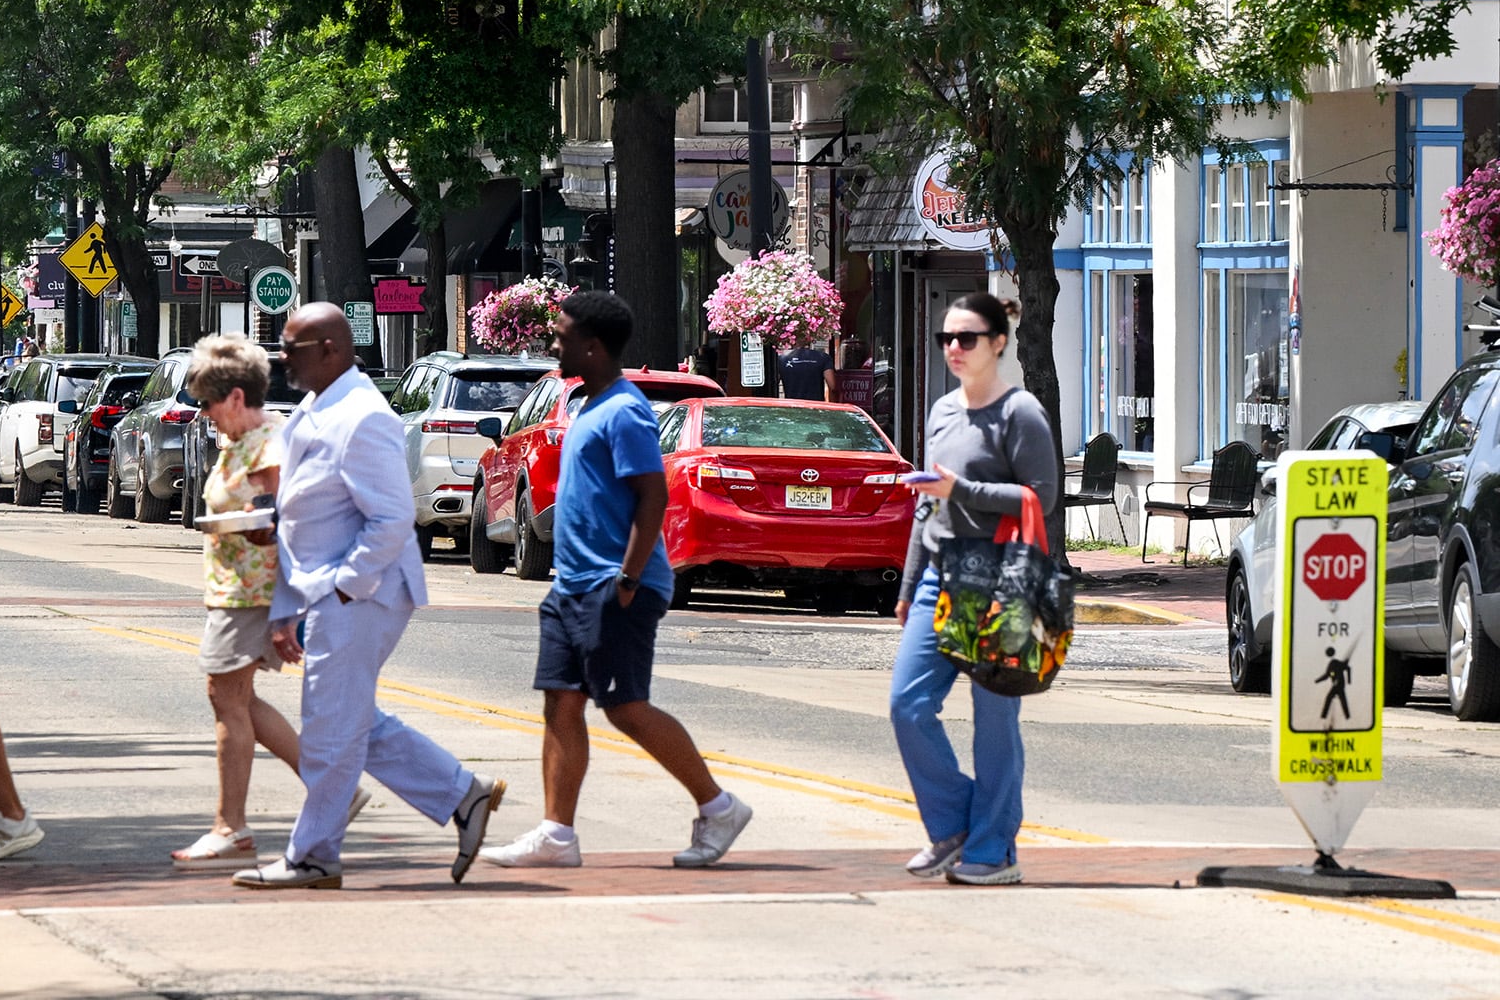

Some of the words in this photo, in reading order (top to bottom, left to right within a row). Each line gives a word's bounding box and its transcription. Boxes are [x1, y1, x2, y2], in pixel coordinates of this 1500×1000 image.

[716, 191, 780, 214] cany
[152, 256, 166, 265] AY
[199, 260, 216, 270] ONE
[266, 276, 283, 286] PAY
[258, 287, 291, 297] STATION
[347, 305, 354, 317] 3
[742, 334, 748, 350] 3
[842, 380, 869, 391] COTTON
[844, 391, 867, 401] CANDY
[1306, 466, 1369, 487] STATE
[1314, 491, 1357, 511] LAW
[1305, 554, 1365, 581] STOP
[1317, 622, 1350, 637] FOR
[1308, 737, 1355, 753] WITHIN
[1290, 757, 1373, 774] CROSSWALK
